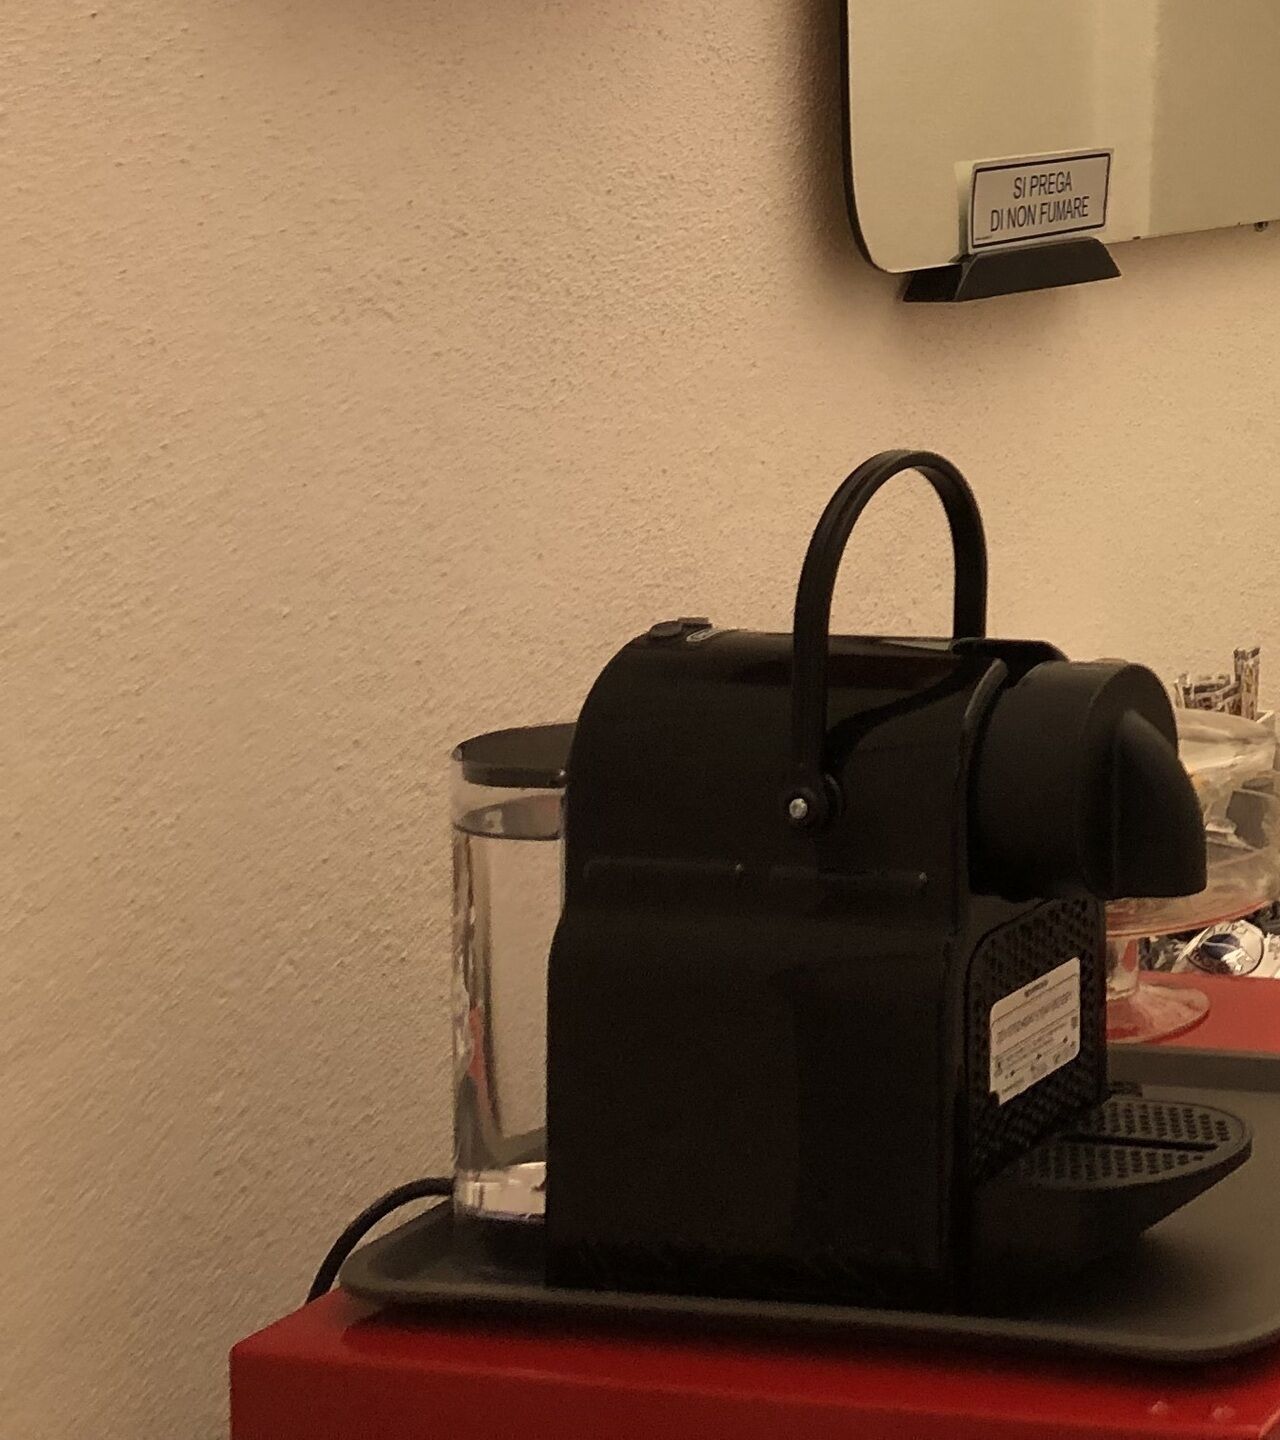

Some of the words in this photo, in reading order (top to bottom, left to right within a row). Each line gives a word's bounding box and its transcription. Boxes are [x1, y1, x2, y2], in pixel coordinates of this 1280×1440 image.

[1012, 176, 1026, 200] SI
[1030, 171, 1072, 197] PREGA
[990, 208, 1004, 232] DI
[1007, 203, 1037, 230] NON
[1039, 196, 1090, 225] FUMARE
